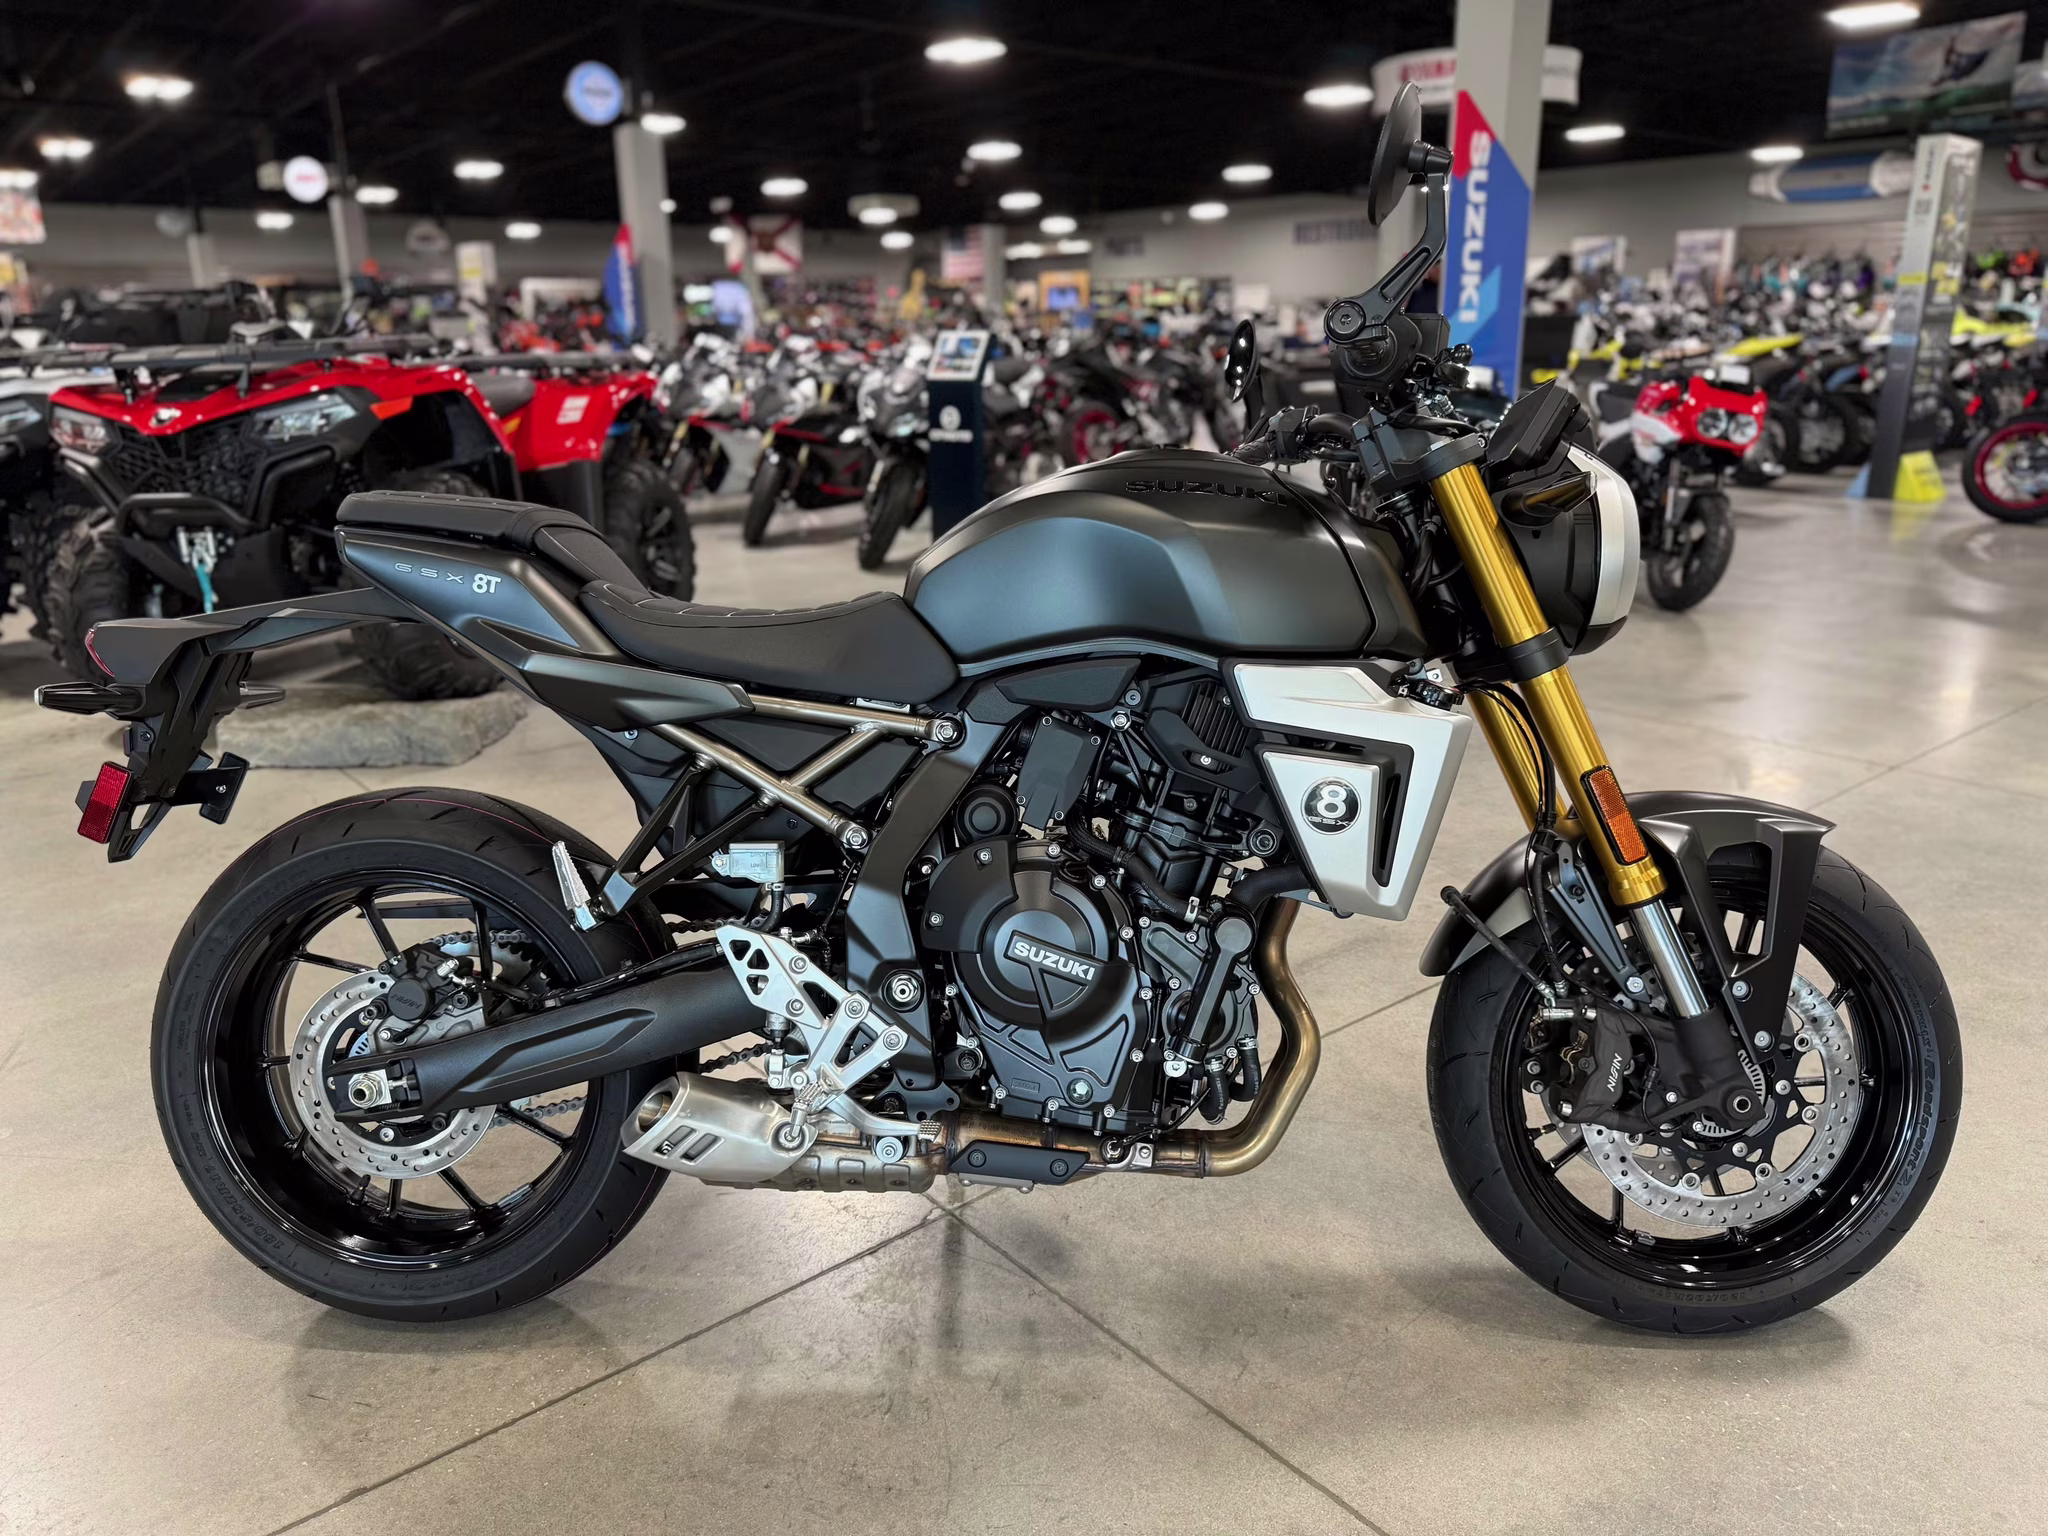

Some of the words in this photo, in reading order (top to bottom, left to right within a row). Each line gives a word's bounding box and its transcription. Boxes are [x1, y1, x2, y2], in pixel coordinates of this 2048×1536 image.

[1458, 129, 1492, 324] SUZUKI
[1125, 480, 1288, 507] SUZUKI
[472, 573, 502, 594] 8T
[1316, 784, 1348, 818] 8
[1014, 941, 1096, 981] SUZUKI
